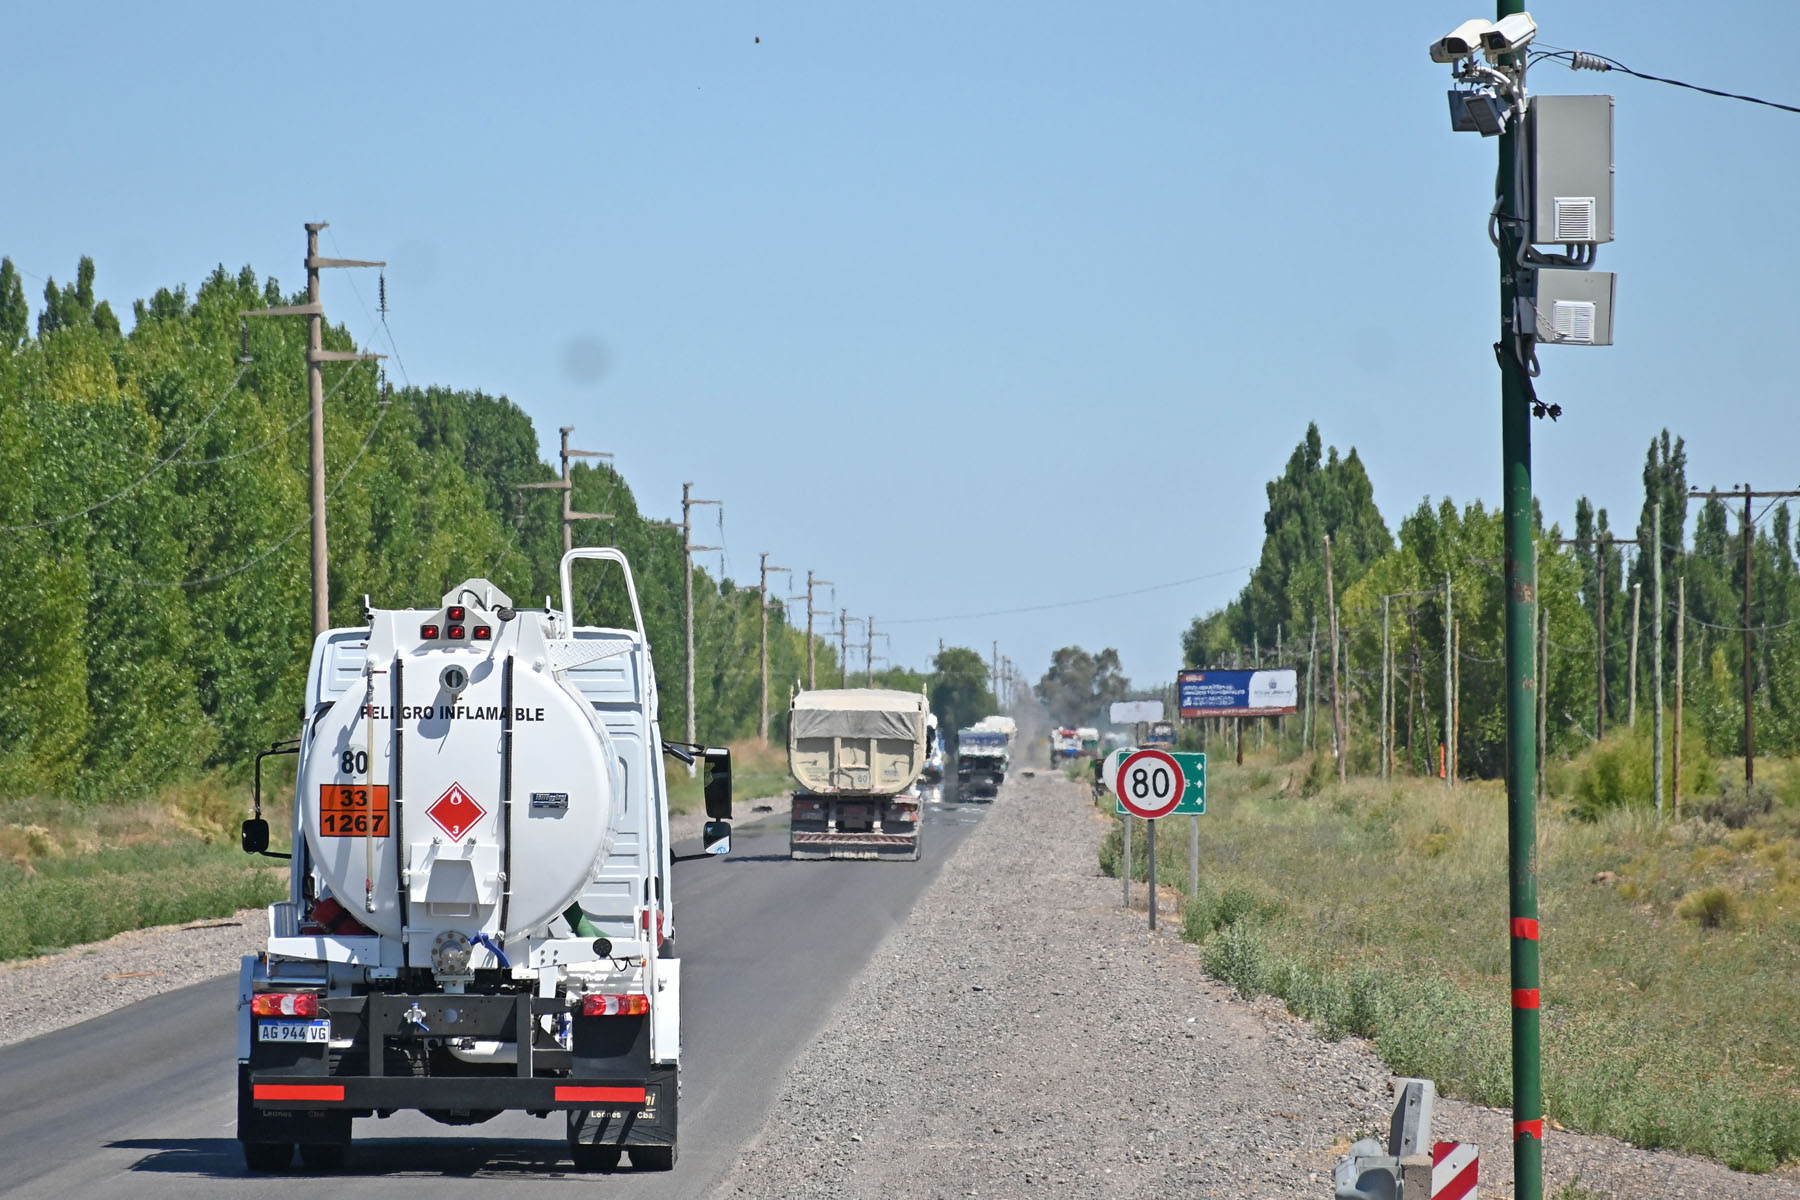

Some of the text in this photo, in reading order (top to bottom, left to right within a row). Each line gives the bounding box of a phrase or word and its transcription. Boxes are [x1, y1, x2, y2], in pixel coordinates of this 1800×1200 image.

[360, 706, 544, 721] PELIGRO INFLAMABLE
[341, 750, 368, 774] 80
[1132, 768, 1169, 798] 80
[340, 790, 367, 806] 33
[324, 814, 384, 832] 1267
[452, 825, 460, 834] 3
[262, 1026, 326, 1040] AG 944 VG
